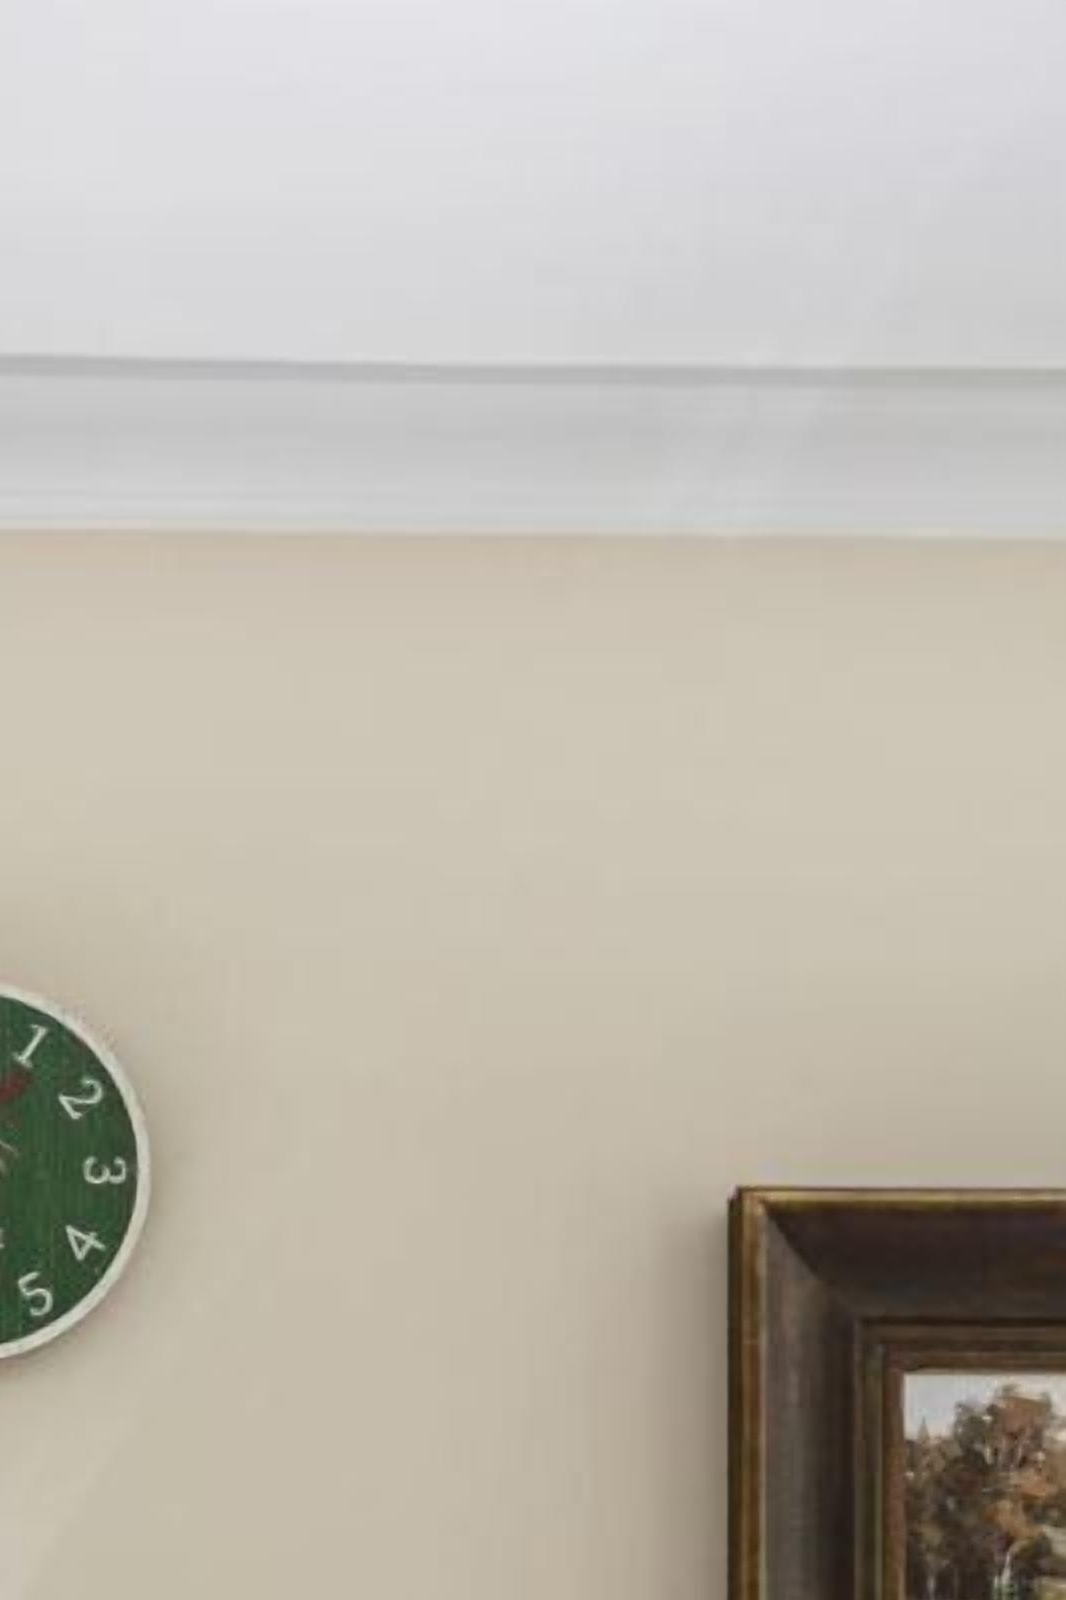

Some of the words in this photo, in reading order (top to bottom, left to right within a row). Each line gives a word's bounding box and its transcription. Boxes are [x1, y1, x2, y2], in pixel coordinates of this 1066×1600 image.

[13, 1024, 48, 1068] 1
[57, 1077, 104, 1121] 2
[83, 1156, 127, 1185] 3
[65, 1224, 106, 1262] 4
[17, 1271, 54, 1317] 5
